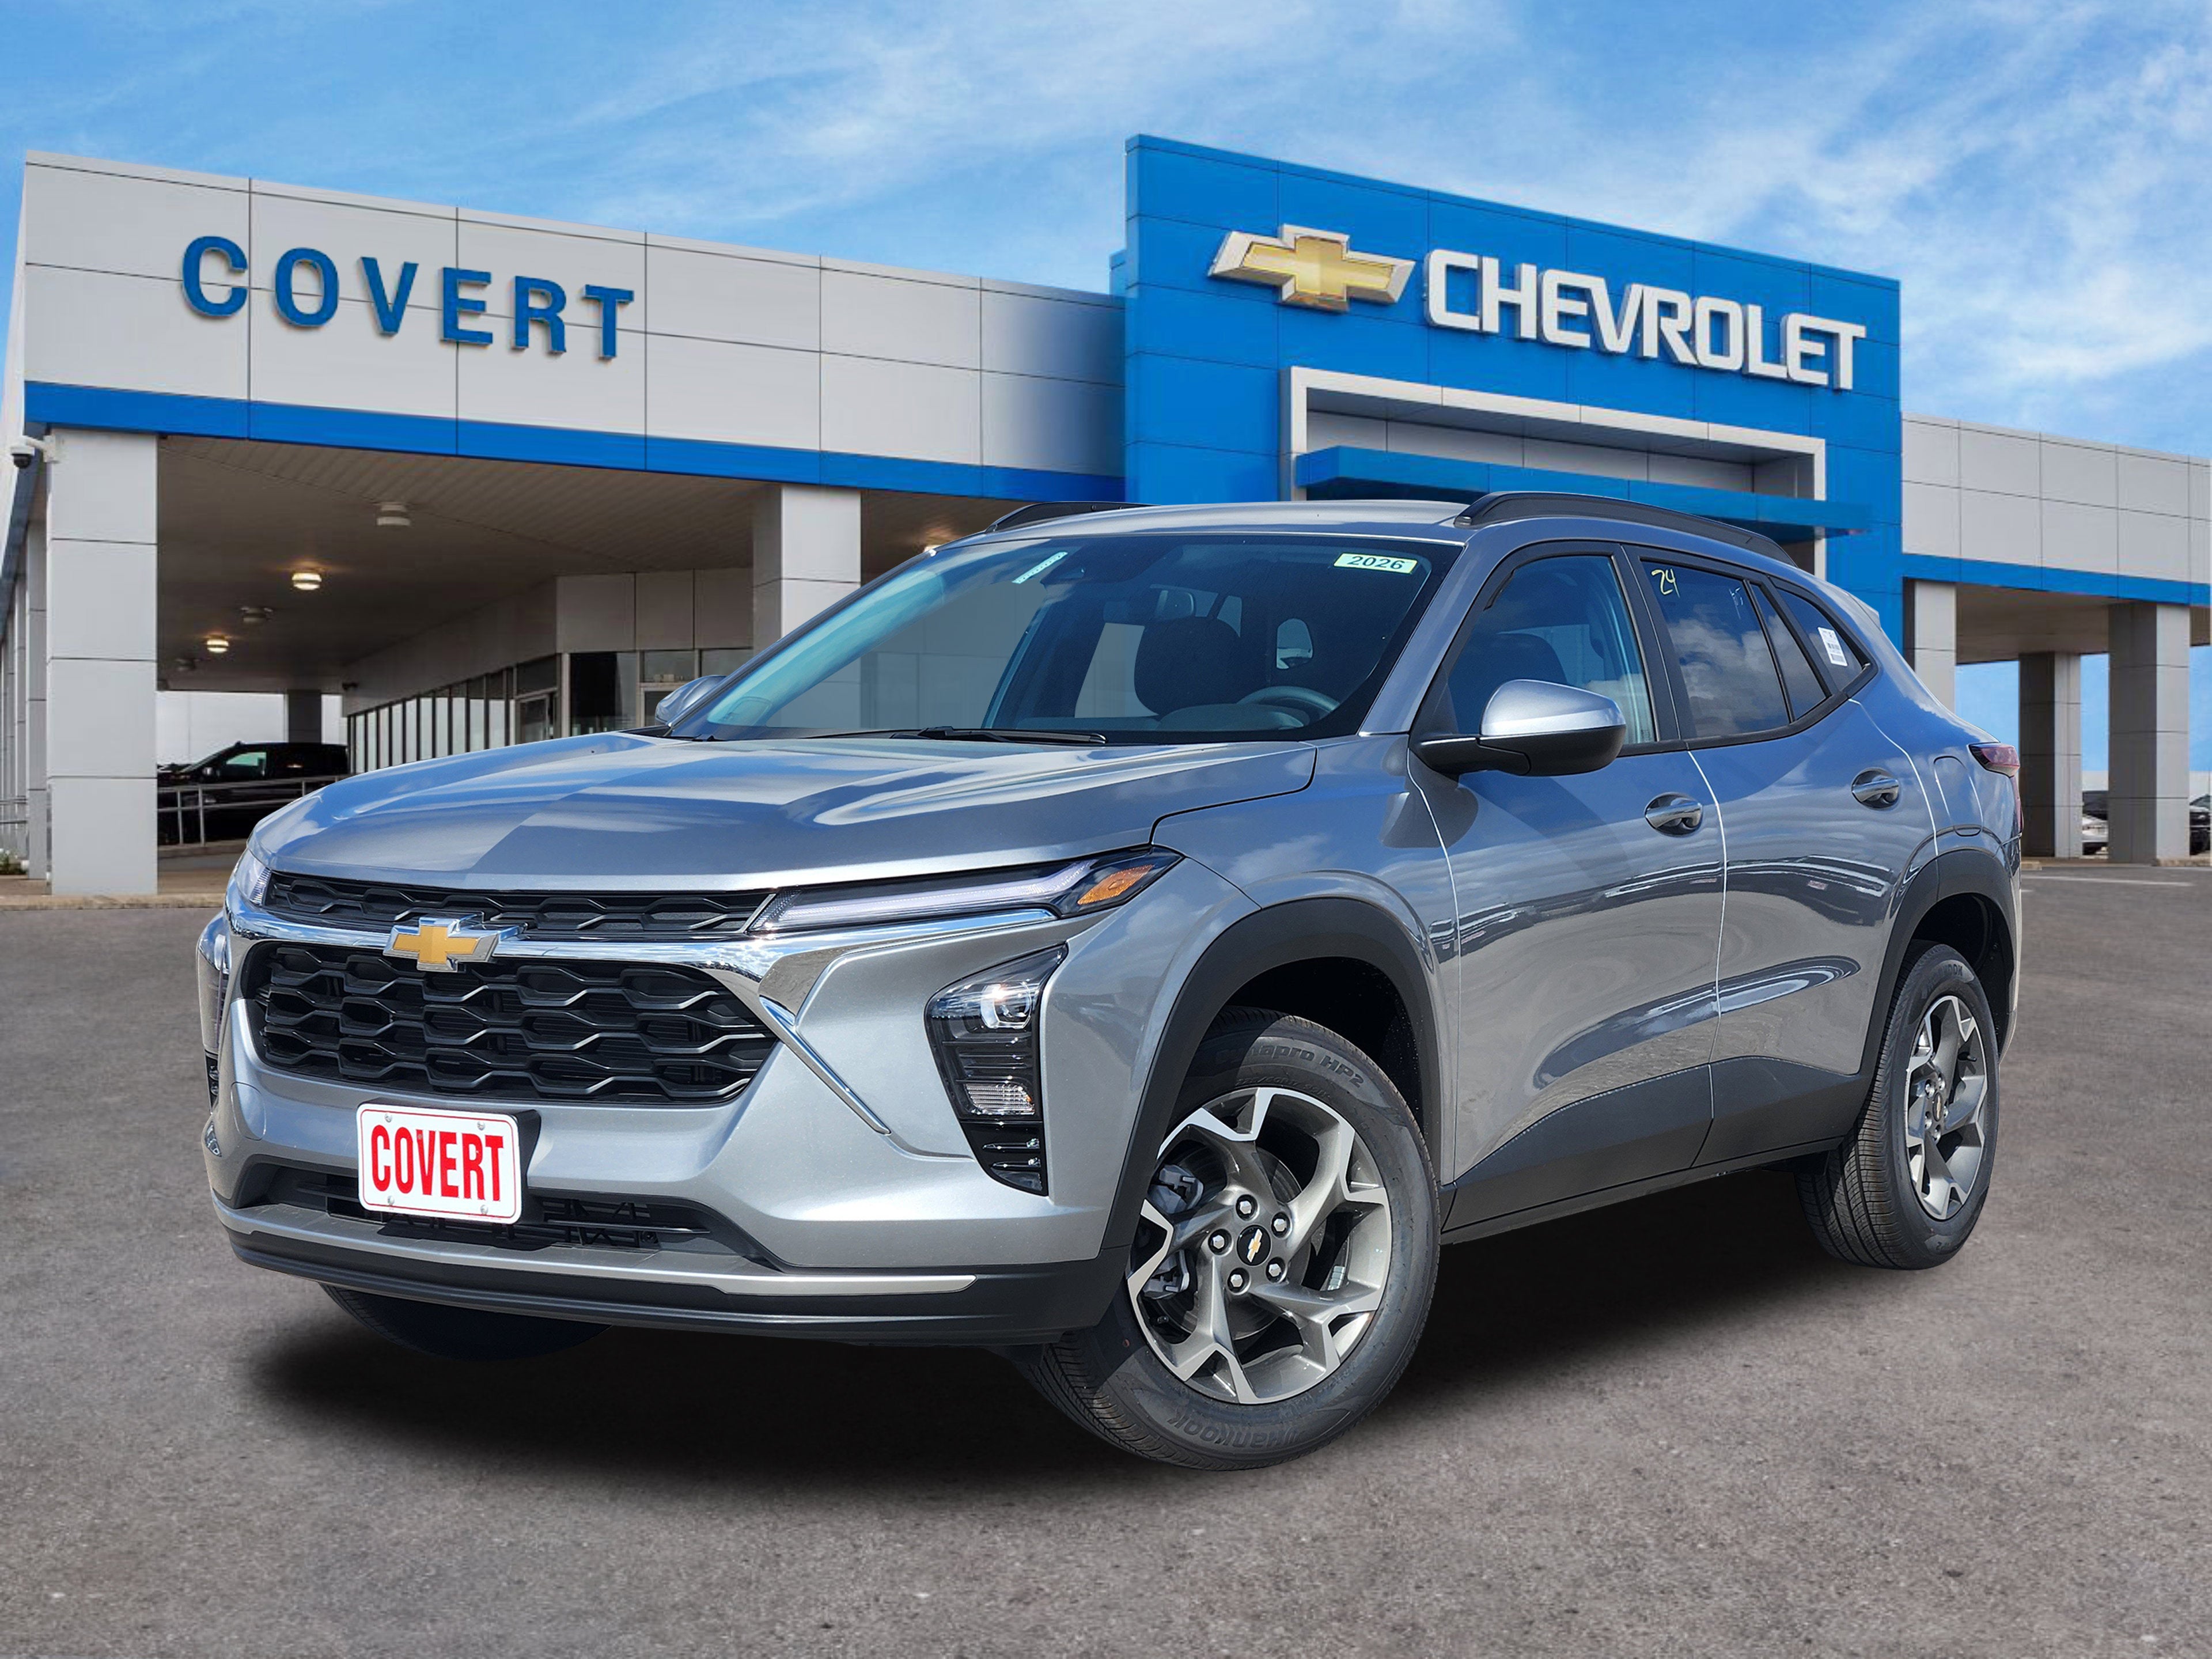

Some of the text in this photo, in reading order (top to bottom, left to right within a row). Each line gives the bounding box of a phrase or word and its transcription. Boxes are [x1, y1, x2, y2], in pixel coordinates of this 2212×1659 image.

[181, 236, 634, 359] COVERT
[1426, 249, 1866, 390] CHEVROLET
[1347, 555, 1406, 569] 2026
[1320, 1052, 1364, 1088] HP2
[371, 1124, 504, 1202] COVERT
